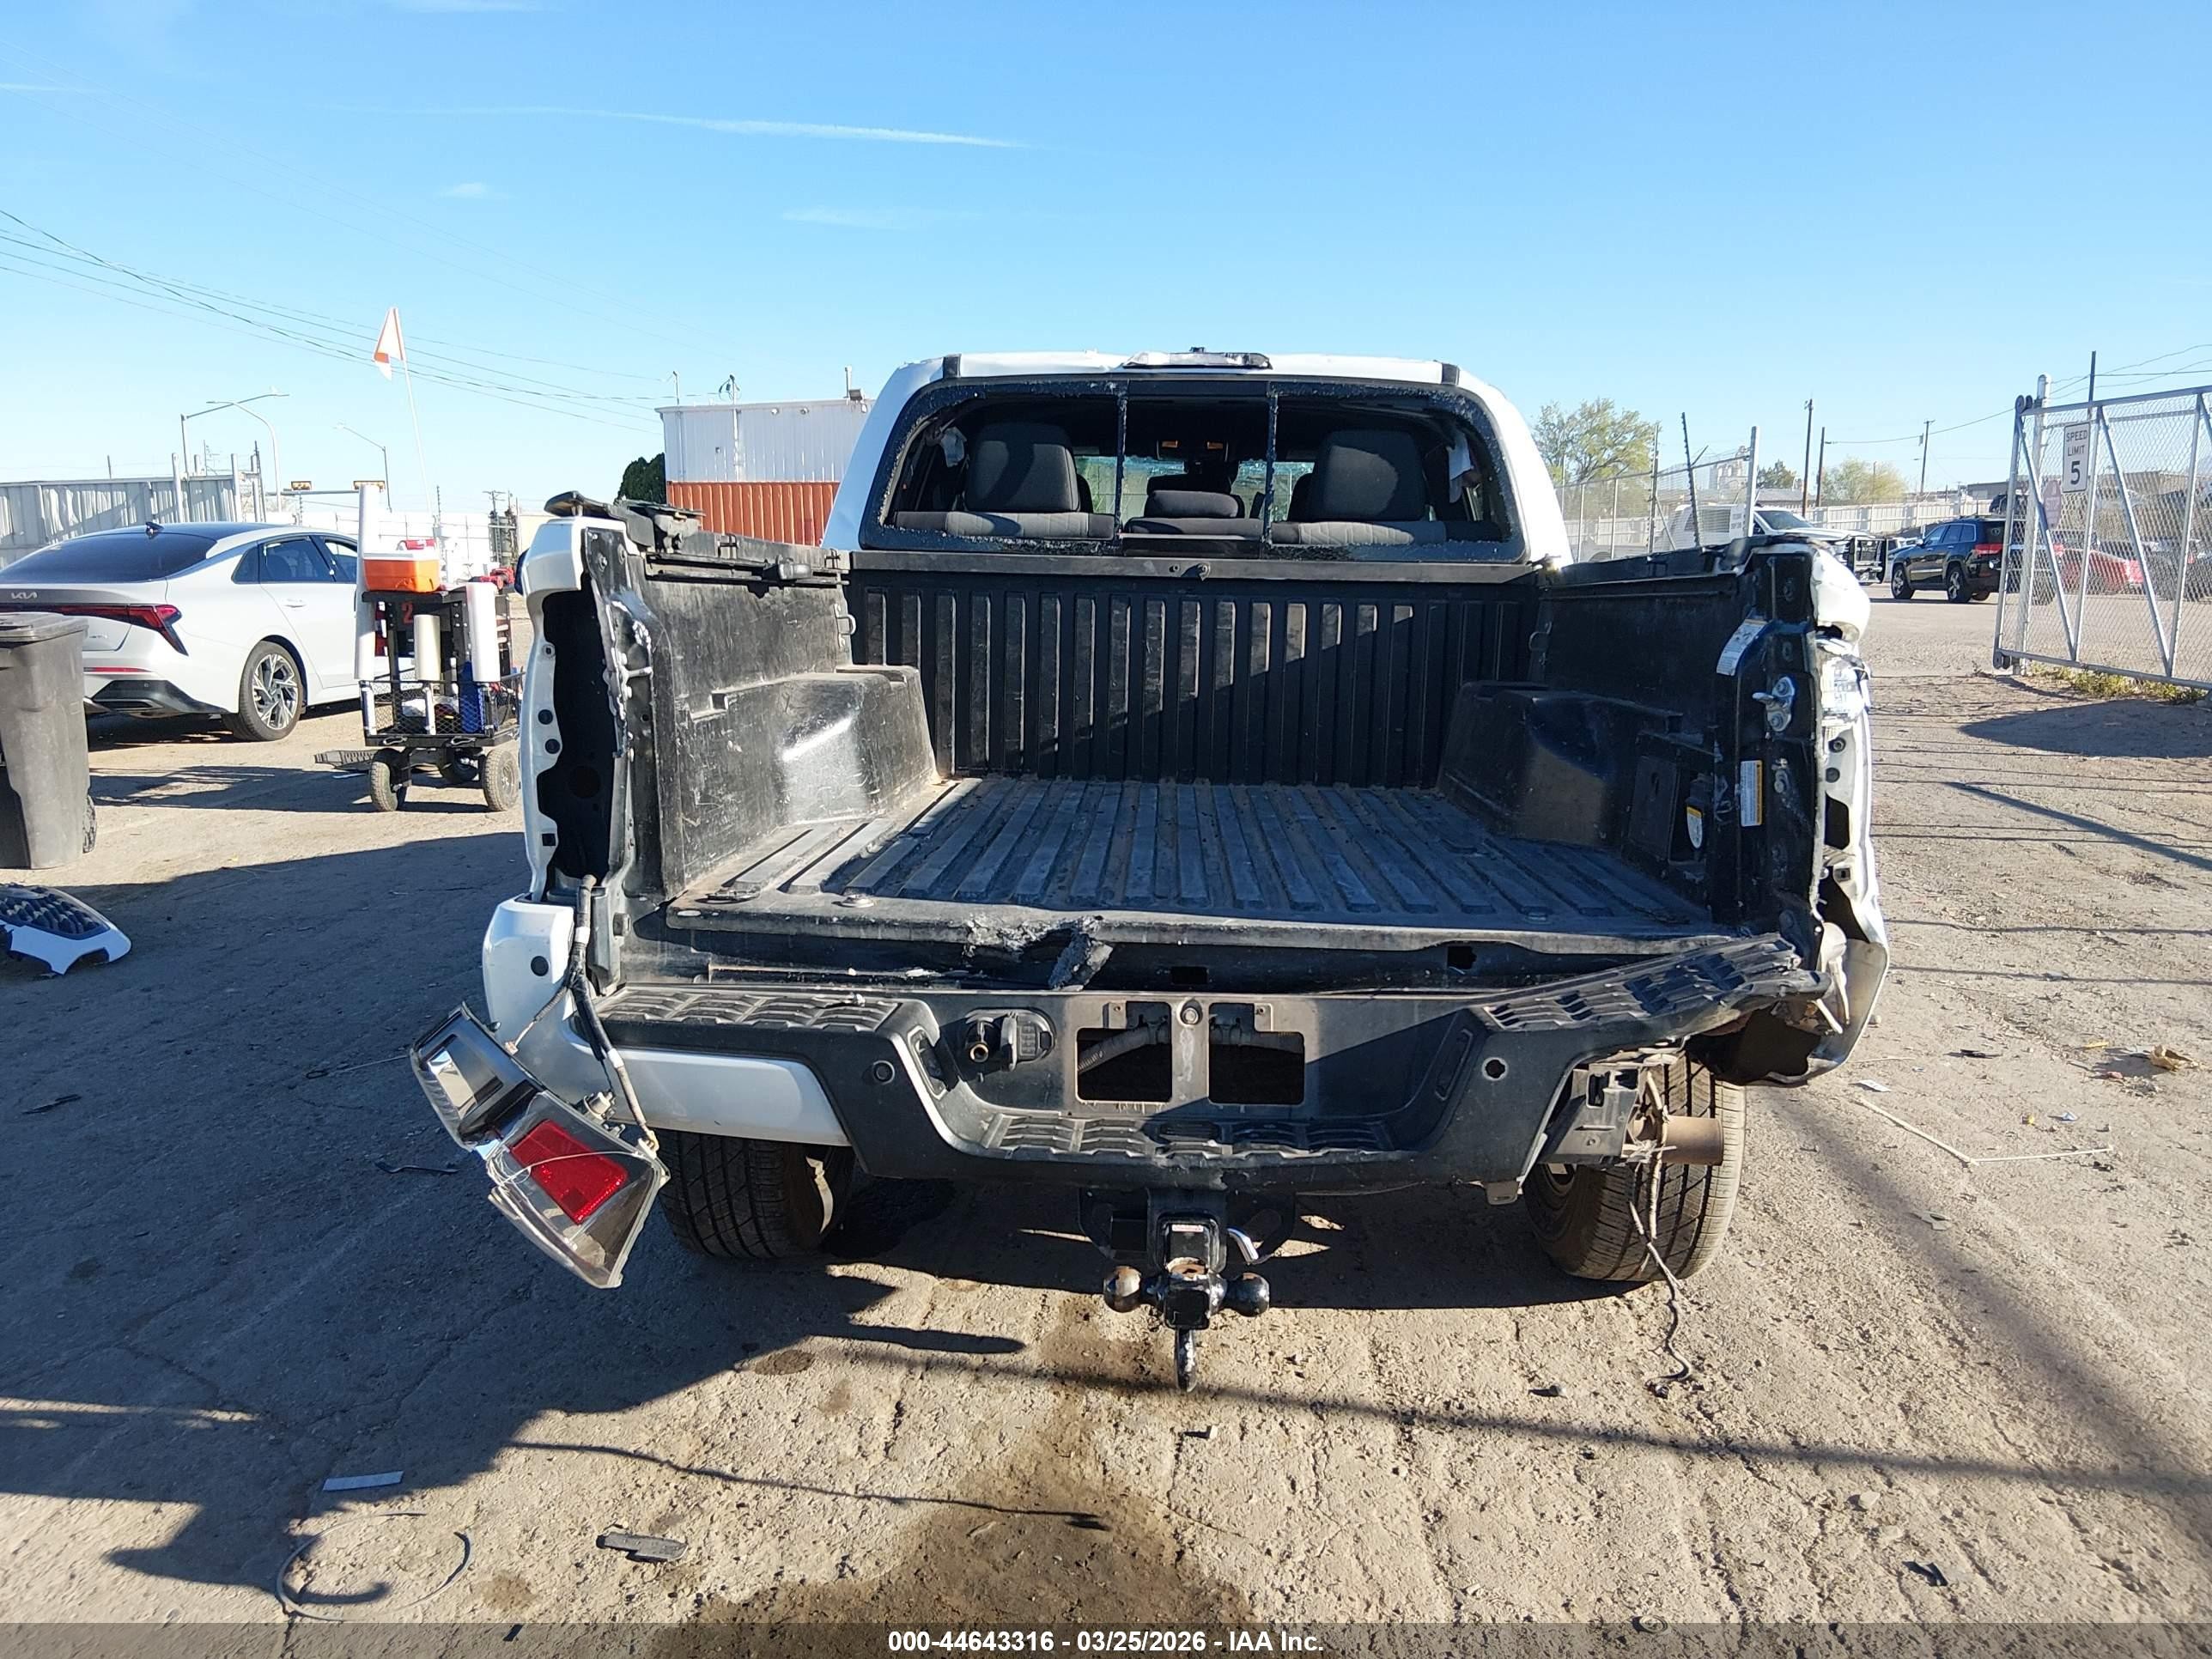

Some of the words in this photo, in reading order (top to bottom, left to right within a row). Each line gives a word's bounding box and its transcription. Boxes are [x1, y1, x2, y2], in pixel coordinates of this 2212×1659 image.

[2066, 430, 2087, 442] SPEED
[2067, 446, 2085, 457] LIMIT
[2070, 461, 2081, 485] 5
